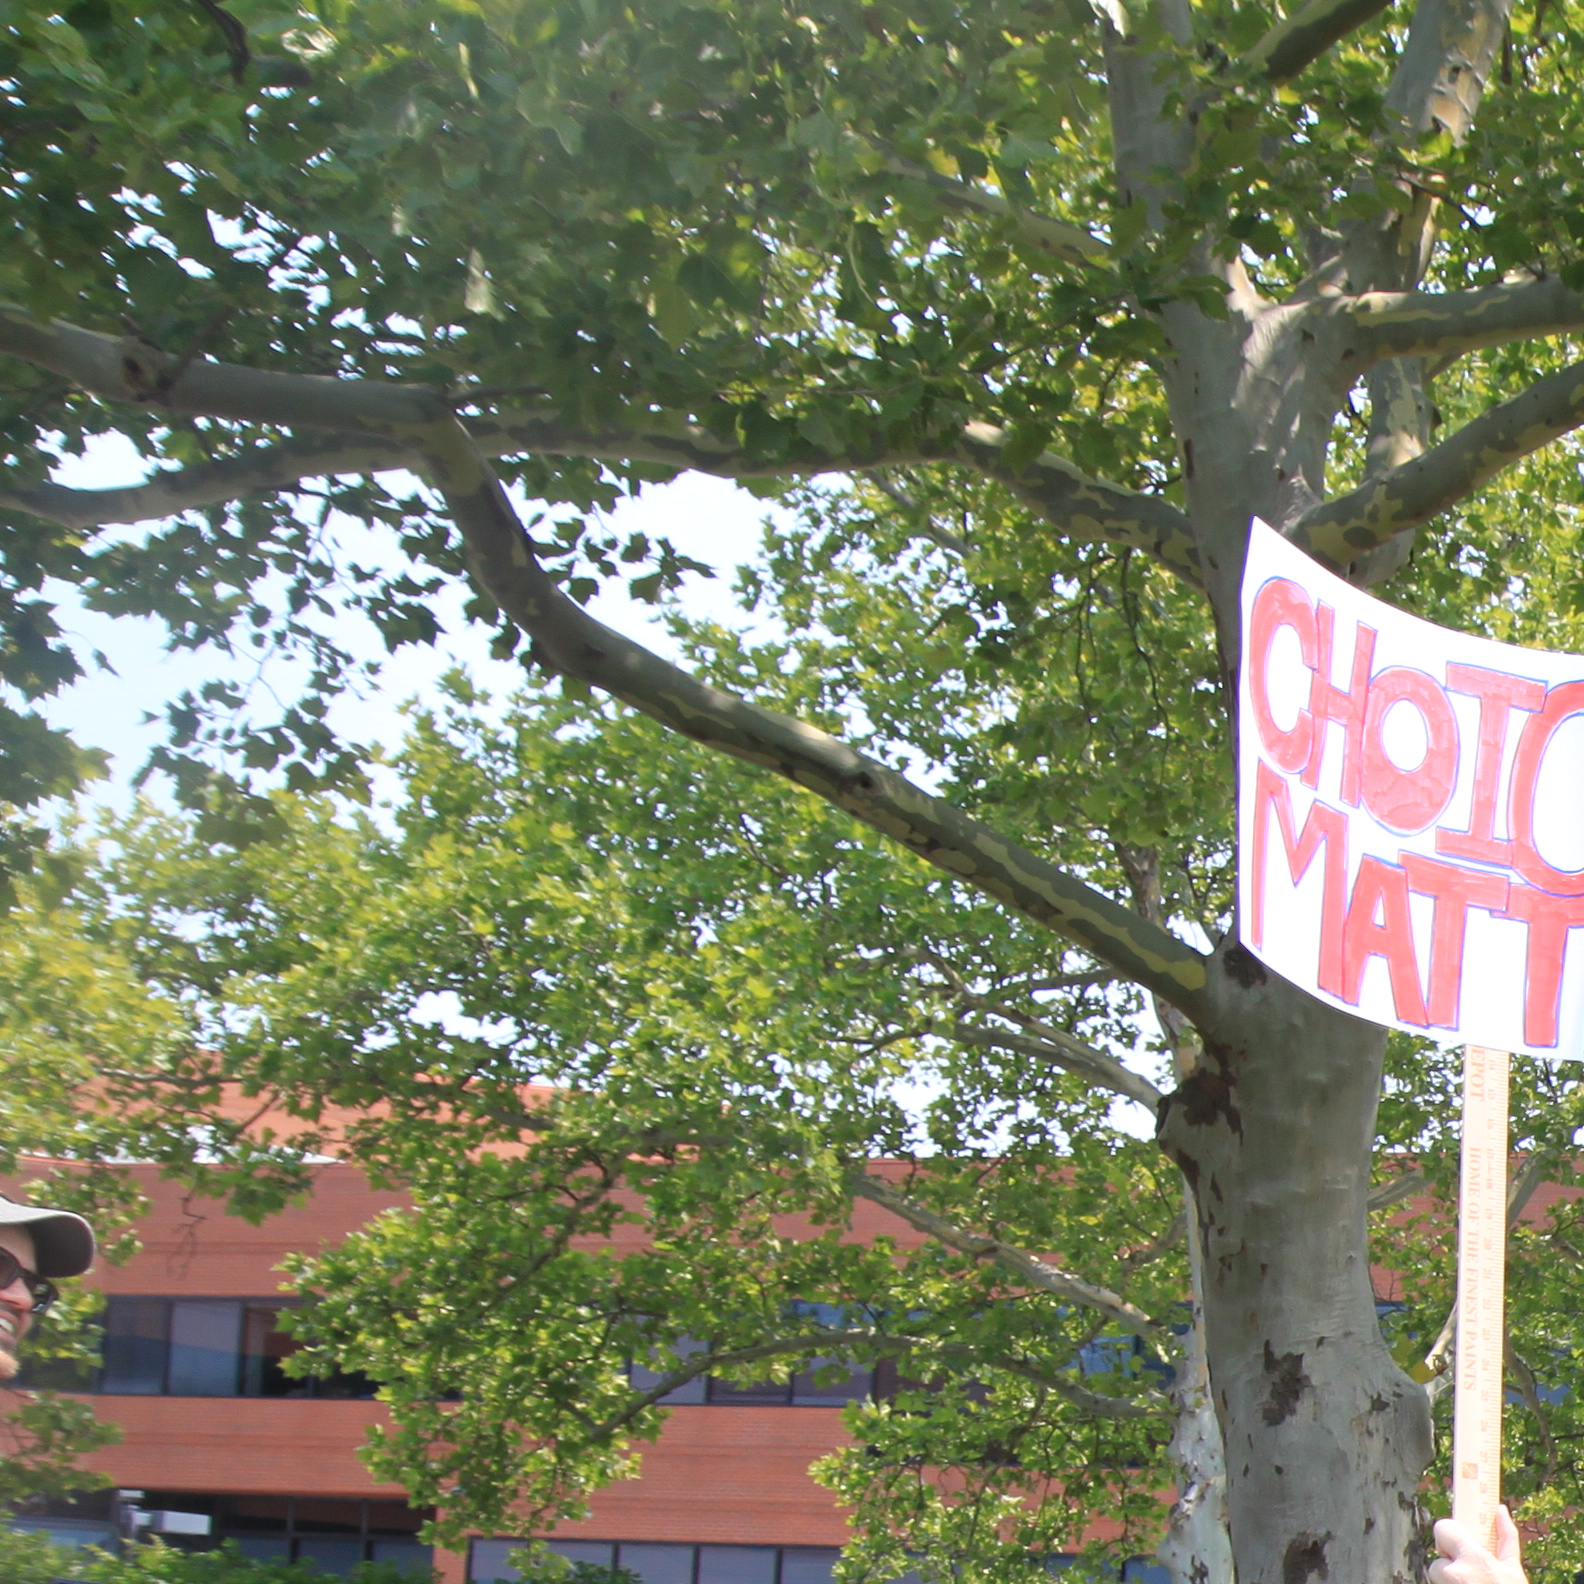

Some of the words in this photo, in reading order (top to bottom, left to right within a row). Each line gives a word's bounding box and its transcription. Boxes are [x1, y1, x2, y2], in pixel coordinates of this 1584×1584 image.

[1470, 1048, 1485, 1102] EPOT
[1469, 1147, 1481, 1198] HOME
[1467, 1202, 1480, 1226] OF
[1466, 1230, 1479, 1263] THE
[1465, 1267, 1479, 1326] FINEST
[1463, 1330, 1478, 1391] PAINTS
